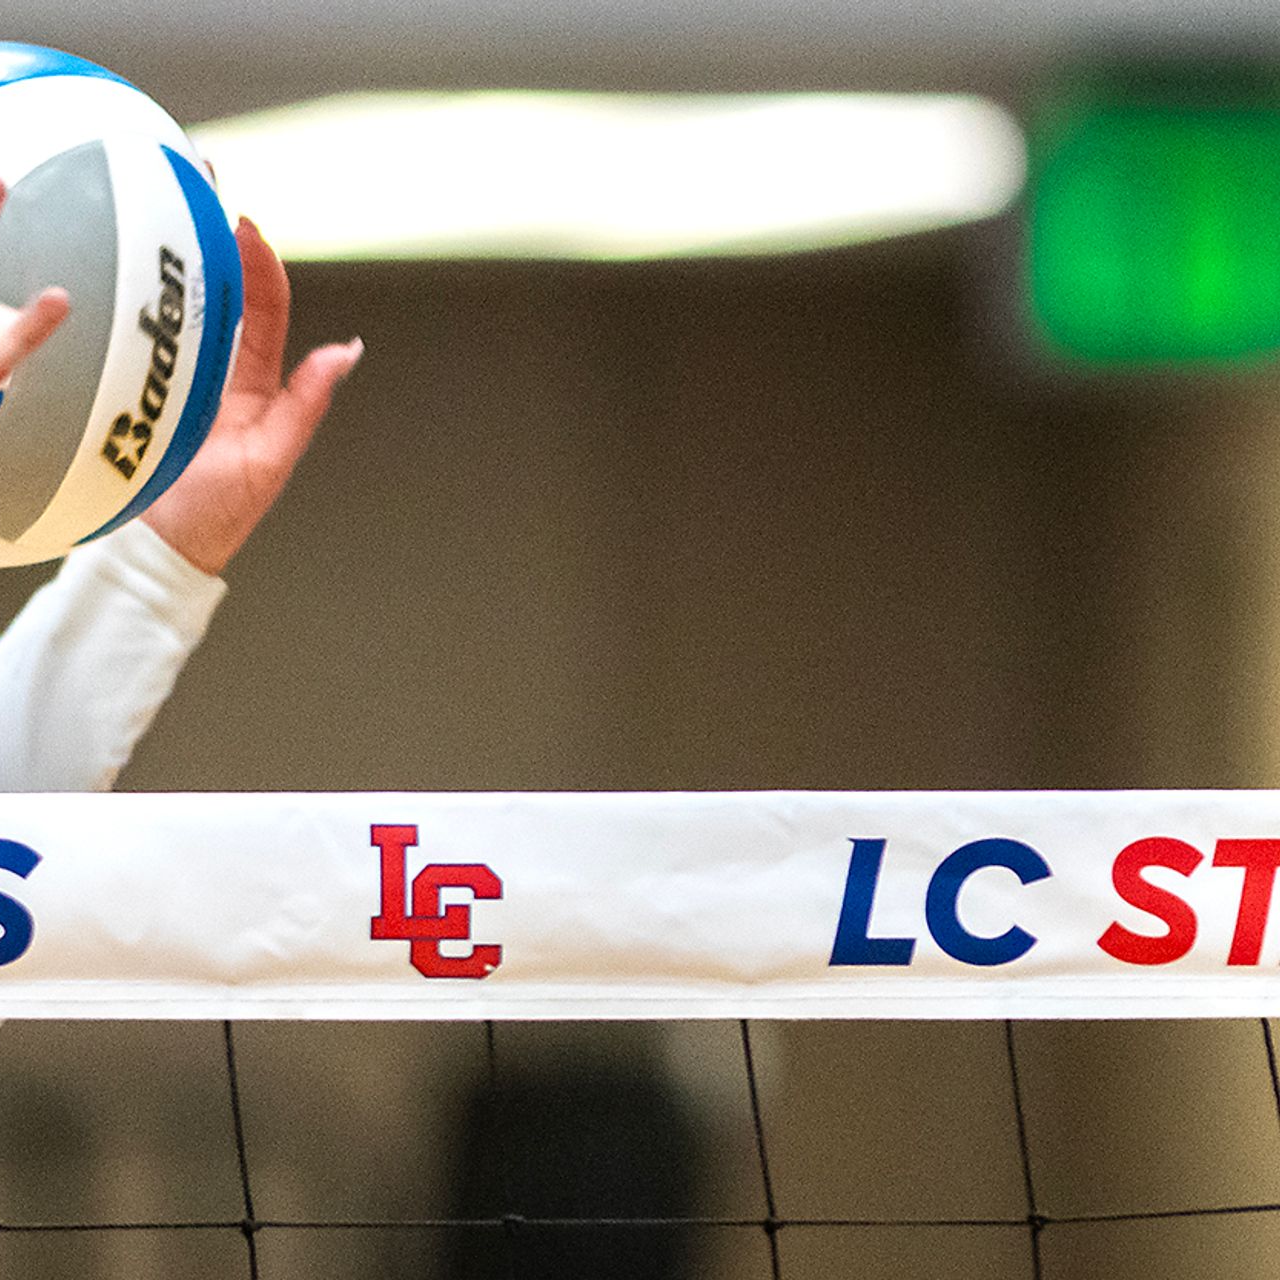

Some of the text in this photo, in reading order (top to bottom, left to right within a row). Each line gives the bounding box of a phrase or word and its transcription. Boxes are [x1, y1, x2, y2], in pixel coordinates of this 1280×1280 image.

[101, 245, 185, 480] Baden
[370, 825, 503, 979] LC
[830, 837, 1051, 967] LC
